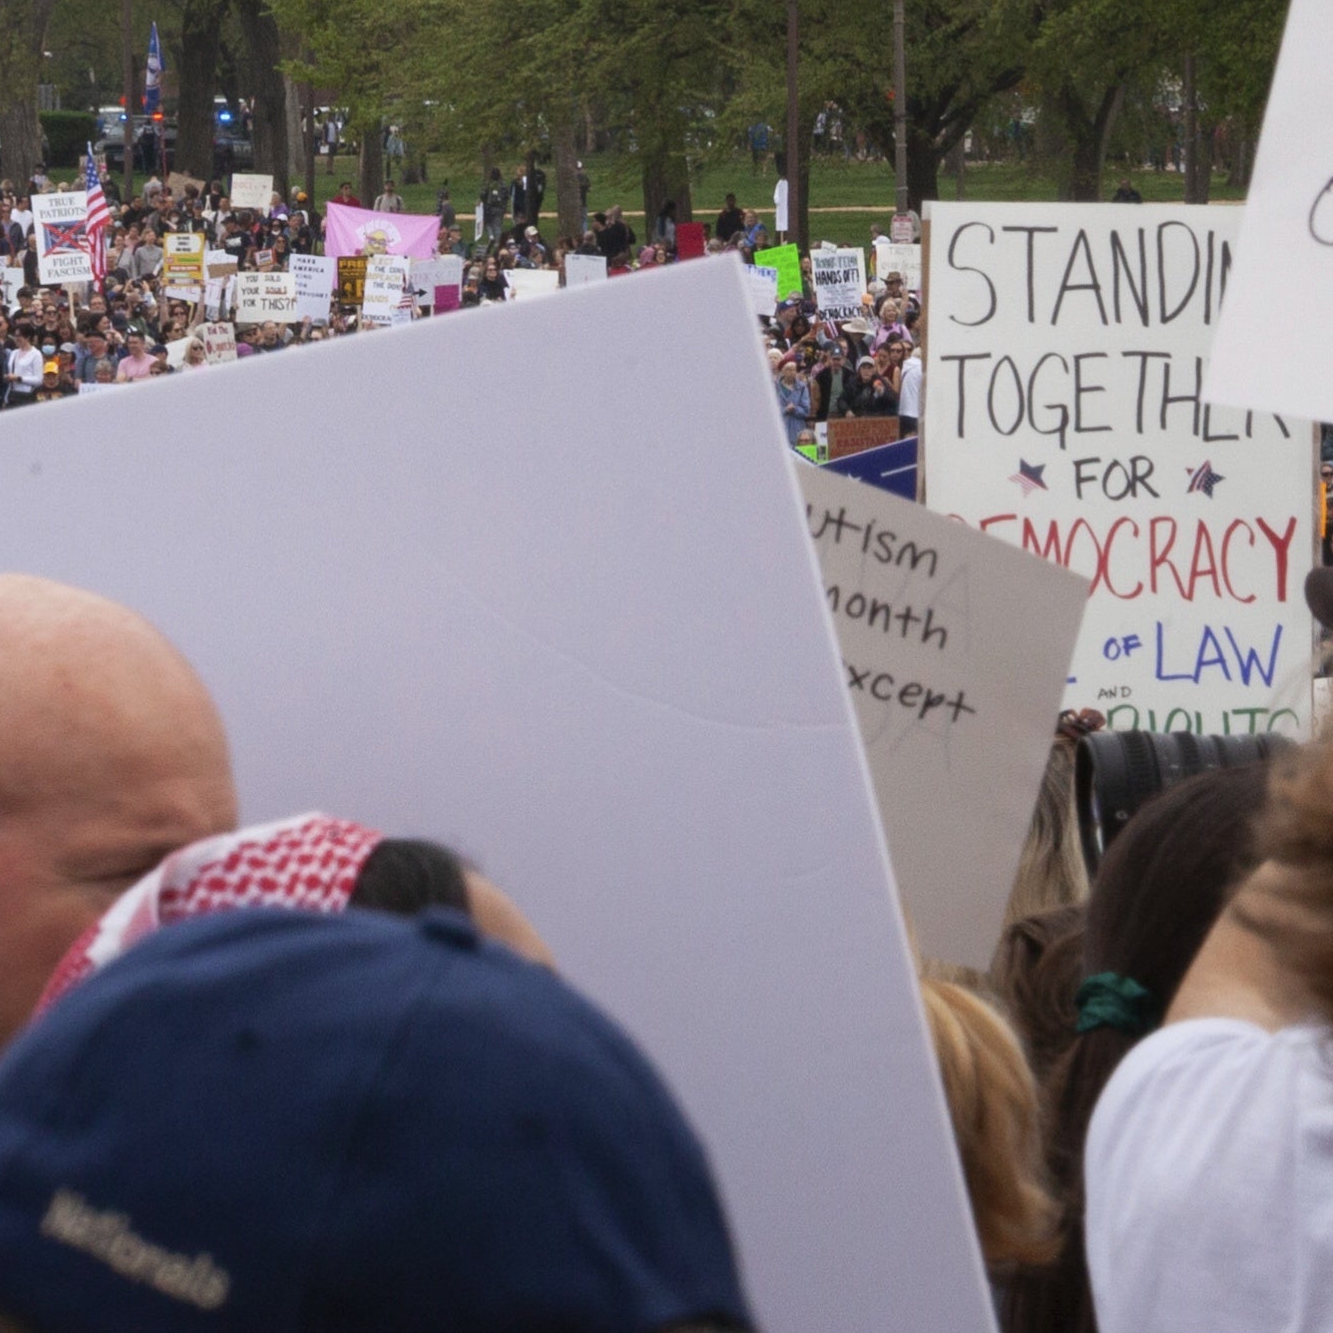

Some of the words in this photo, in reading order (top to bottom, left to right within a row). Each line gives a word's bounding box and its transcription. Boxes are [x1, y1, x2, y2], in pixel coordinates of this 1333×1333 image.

[48, 196, 76, 208] TRUE
[39, 206, 87, 219] PATRIOTS
[52, 256, 84, 267] FIGHT
[47, 265, 91, 279] FASCISM
[293, 265, 325, 274] AMERICA
[947, 219, 1233, 327] STANDI
[244, 274, 259, 283] YOU
[264, 274, 282, 283] SOLD
[814, 268, 842, 286] HANDS
[241, 286, 260, 295] YOUR
[242, 298, 257, 309] FOR
[1072, 454, 1160, 501] FOR
[1102, 634, 1143, 661] OF
[1154, 620, 1283, 688] LAW
[846, 664, 977, 723] xcept
[1097, 684, 1132, 700] AND
